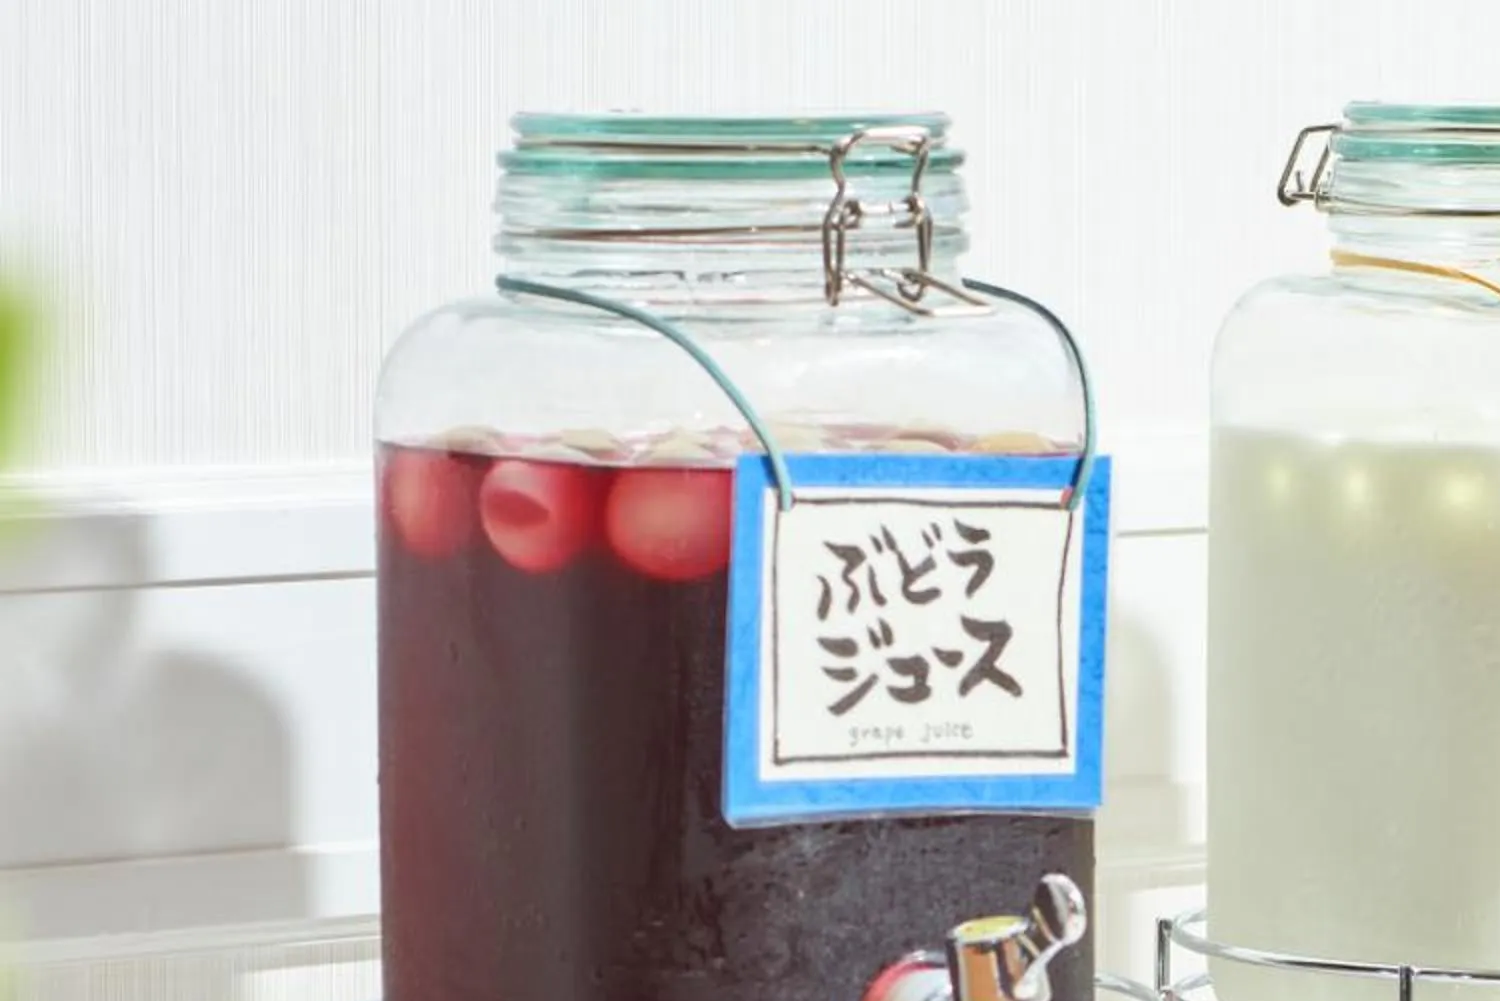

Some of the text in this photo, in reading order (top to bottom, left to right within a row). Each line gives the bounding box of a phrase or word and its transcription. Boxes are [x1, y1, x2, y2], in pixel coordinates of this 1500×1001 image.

[816, 519, 995, 621] ぶどう
[816, 615, 1023, 717] ジュース
[848, 721, 974, 747] grape juice
